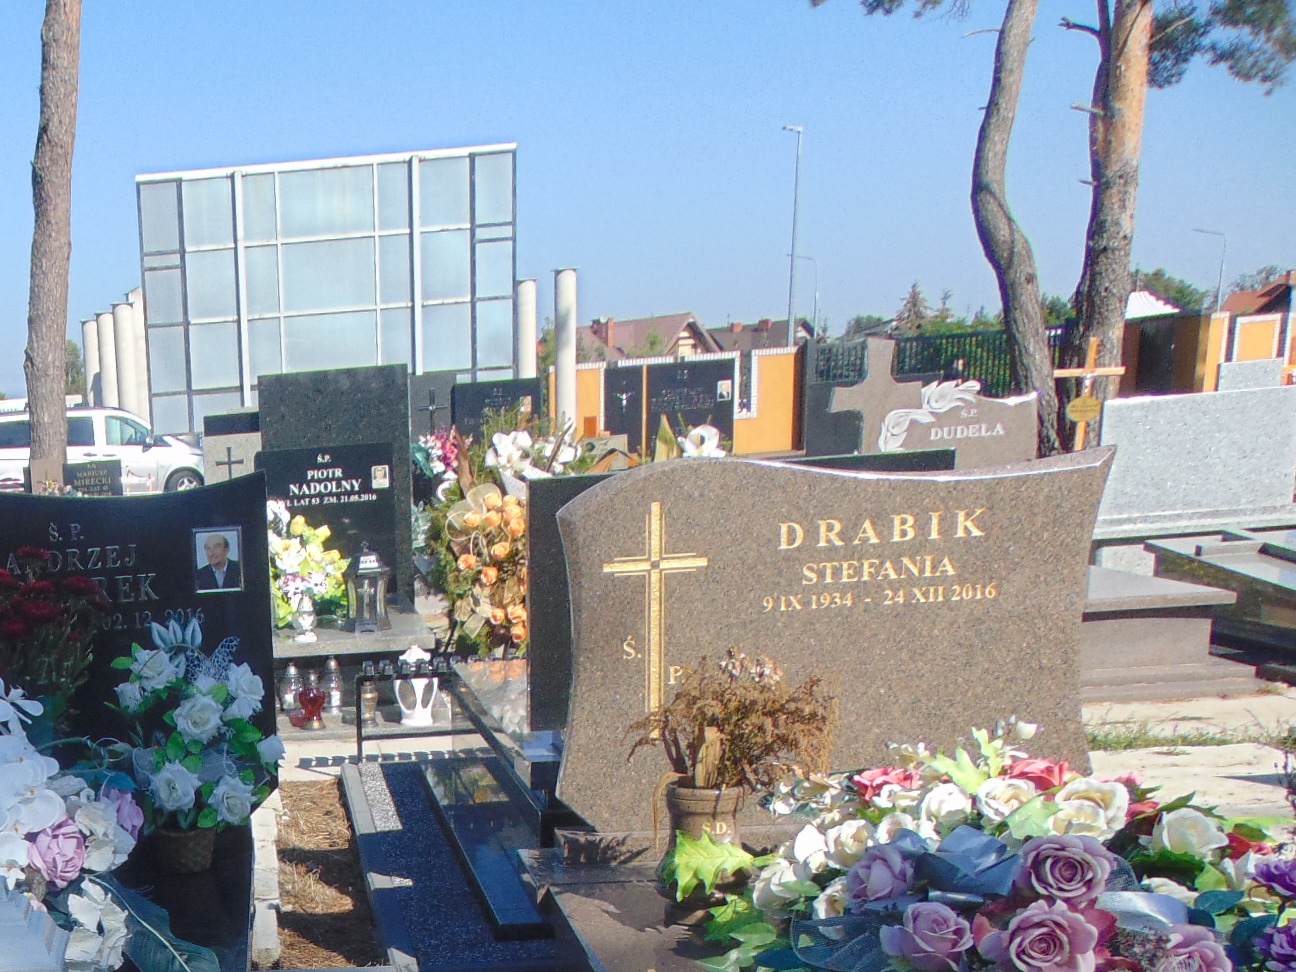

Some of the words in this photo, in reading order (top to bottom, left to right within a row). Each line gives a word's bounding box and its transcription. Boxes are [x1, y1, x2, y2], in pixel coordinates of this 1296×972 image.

[930, 422, 1005, 440] DUDELA
[307, 468, 343, 480] PIOTR
[289, 479, 362, 496] NADOLNY
[294, 499, 310, 507] LAT
[70, 523, 84, 541] P.
[777, 507, 987, 550] DRABIK
[6, 544, 137, 575] ADRZEJ
[802, 554, 956, 585] STEFANIA
[763, 596, 775, 613] 9
[780, 594, 803, 611] IX
[811, 591, 854, 609] 1934
[883, 589, 905, 605] 24
[912, 585, 946, 603] XII
[950, 582, 998, 601] 2016
[623, 633, 642, 659] Ś.
[703, 821, 732, 835] S.D.
